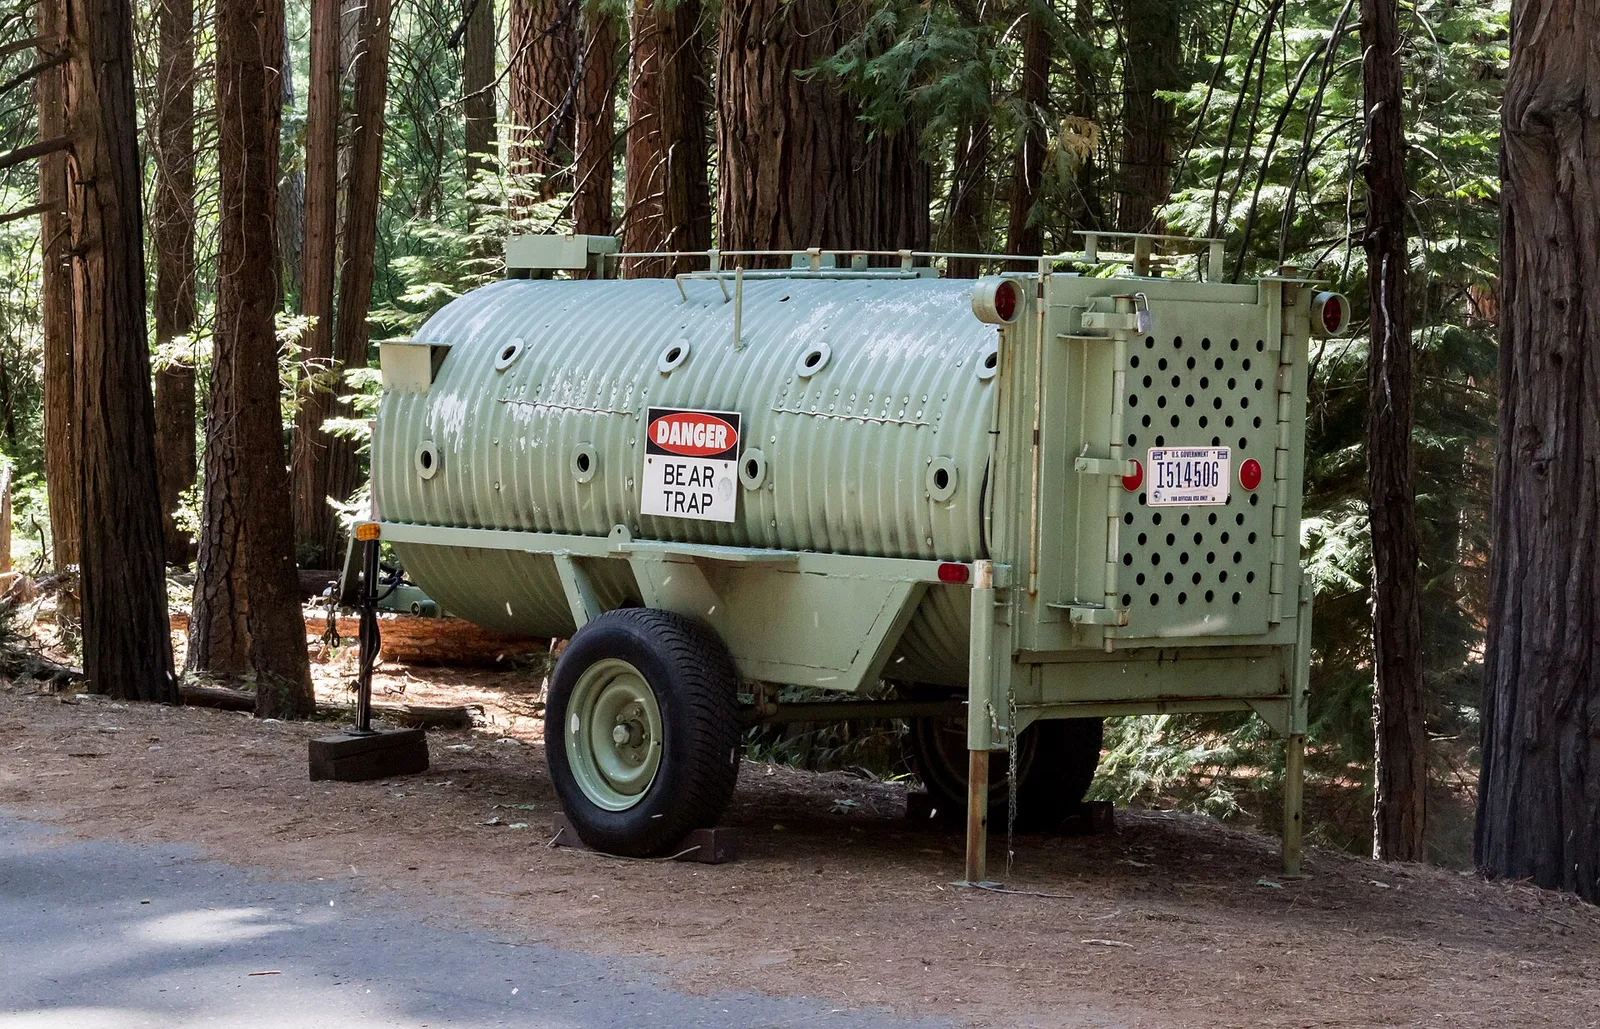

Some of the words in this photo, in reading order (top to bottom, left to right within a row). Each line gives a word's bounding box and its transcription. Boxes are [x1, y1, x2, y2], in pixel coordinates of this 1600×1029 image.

[657, 421, 727, 449] DANGER
[664, 463, 715, 488] BEAR
[1157, 461, 1219, 488] I514506
[663, 490, 713, 514] TRAP
